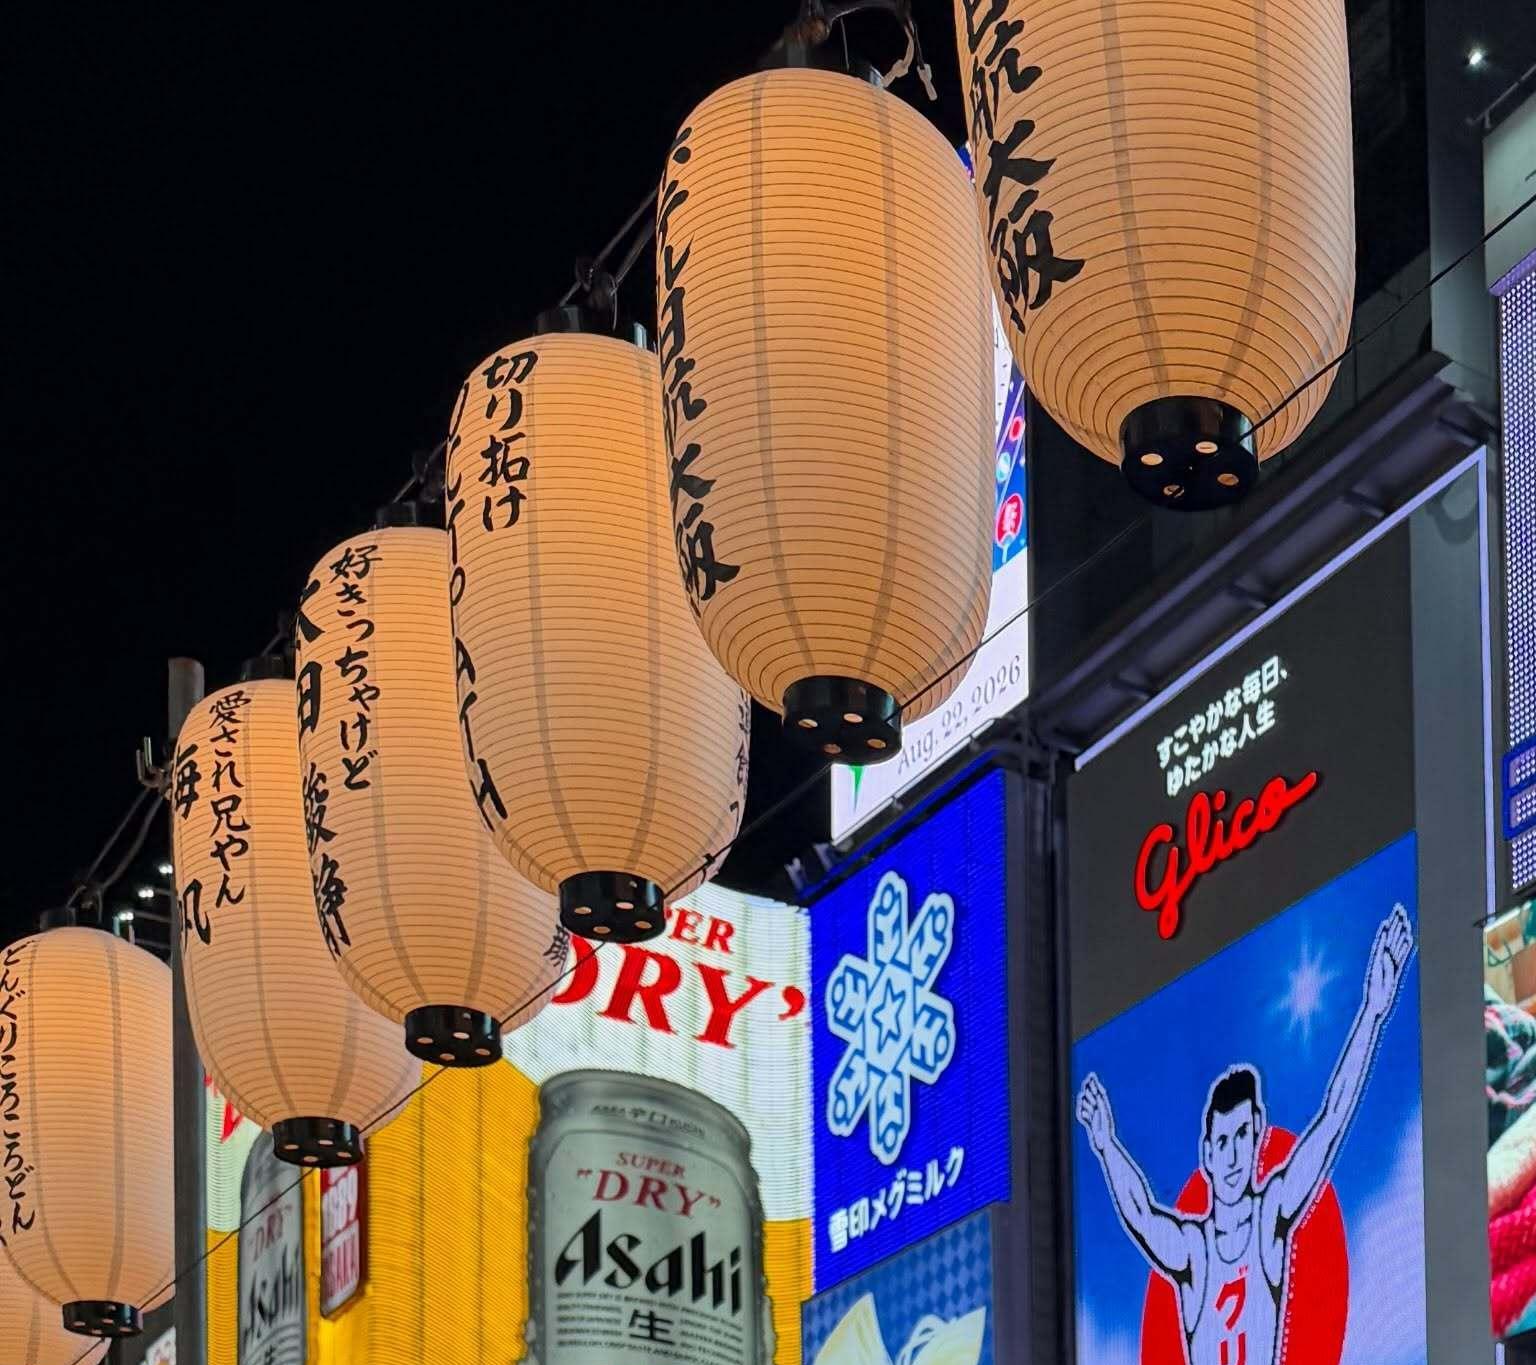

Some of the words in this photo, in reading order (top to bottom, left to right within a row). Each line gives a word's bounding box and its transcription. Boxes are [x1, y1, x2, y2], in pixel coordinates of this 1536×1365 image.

[478, 350, 539, 533] 切り拓け
[329, 544, 382, 790] 好きっちゃけど
[897, 725, 937, 776] Aug.
[972, 653, 1022, 716] 2026
[1156, 655, 1288, 770] すこやかな毎日、
[208, 689, 252, 909] 愛され兄やん
[1166, 698, 1276, 797] ゆたかな人生
[1133, 771, 1317, 939] Glico
[615, 1151, 686, 1179] SUPER
[829, 1146, 965, 1254] 雪印メグミルク
[554, 1208, 742, 1317] Asahi
[628, 1308, 676, 1347] 生
